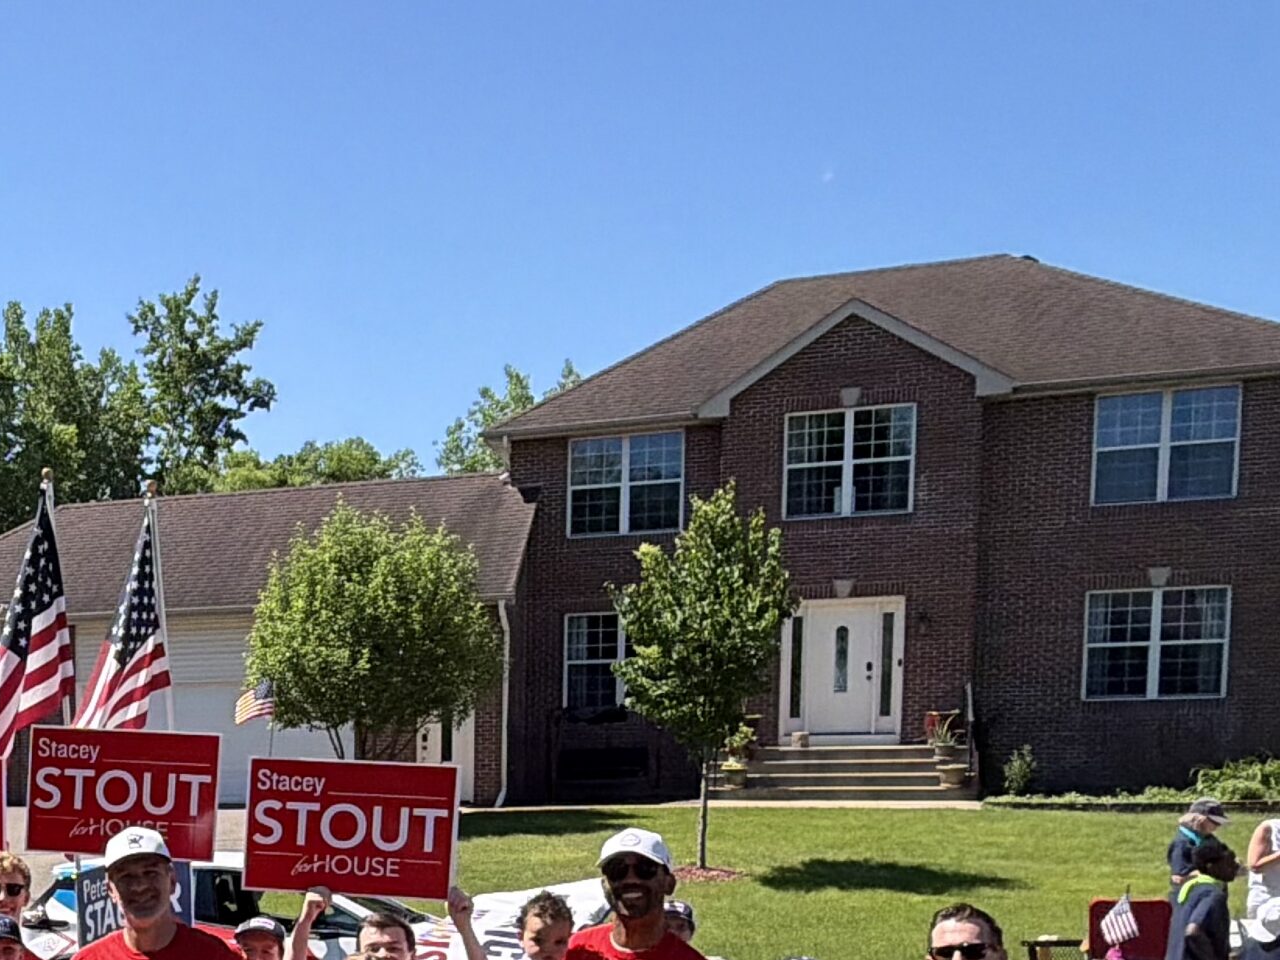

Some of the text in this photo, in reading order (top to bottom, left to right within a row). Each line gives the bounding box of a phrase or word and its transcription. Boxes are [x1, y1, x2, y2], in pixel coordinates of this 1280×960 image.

[38, 737, 100, 764] Stacey
[33, 766, 212, 817] STOUT
[257, 768, 326, 797] Stacey
[252, 799, 449, 853] STOUT
[312, 854, 401, 878] HOUSE
